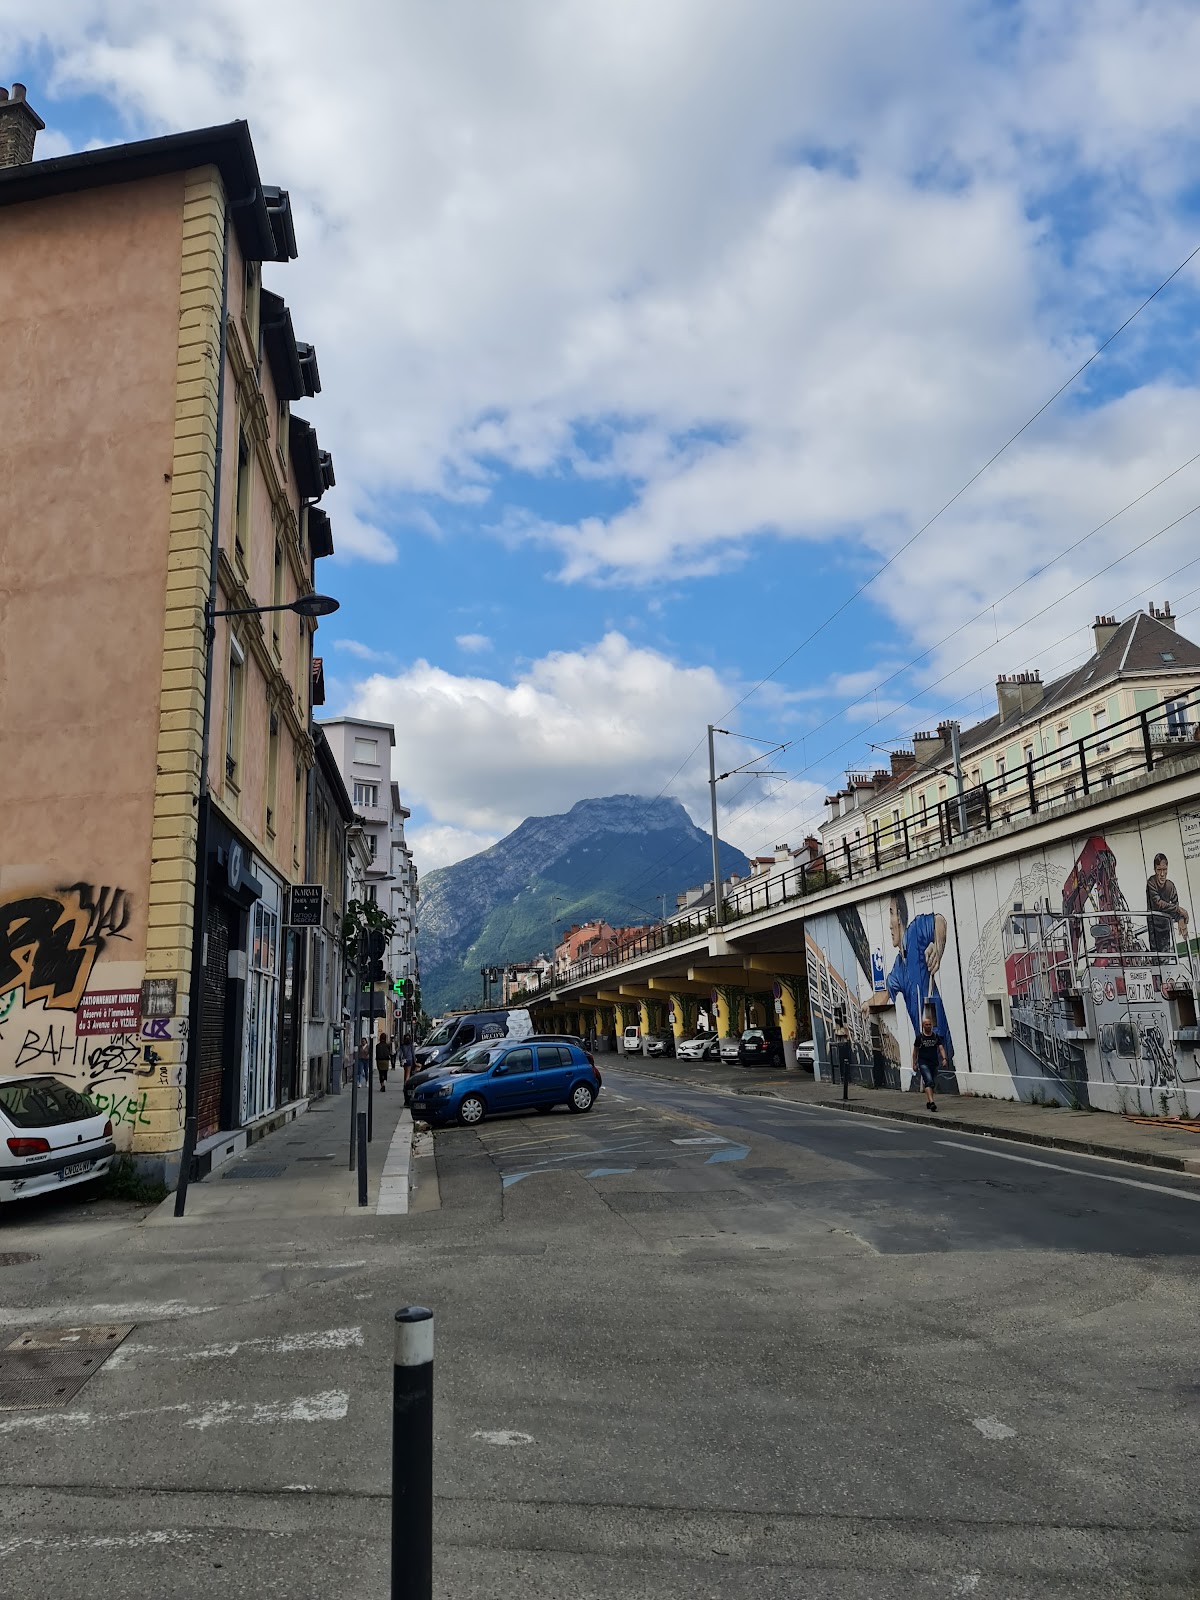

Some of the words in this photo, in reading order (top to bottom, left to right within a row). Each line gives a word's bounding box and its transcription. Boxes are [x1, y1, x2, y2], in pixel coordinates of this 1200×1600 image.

[294, 888, 319, 896] KARMA
[118, 993, 140, 1004] INTERDIT
[83, 1009, 102, 1019] Réservé
[103, 1008, 107, 1018] à
[108, 1006, 135, 1017] l'immeuble
[79, 1020, 86, 1030] du
[87, 1020, 91, 1029] 3
[92, 1019, 110, 1029] Avenue
[111, 1018, 118, 1028] de
[120, 1017, 138, 1028] VIZILLE
